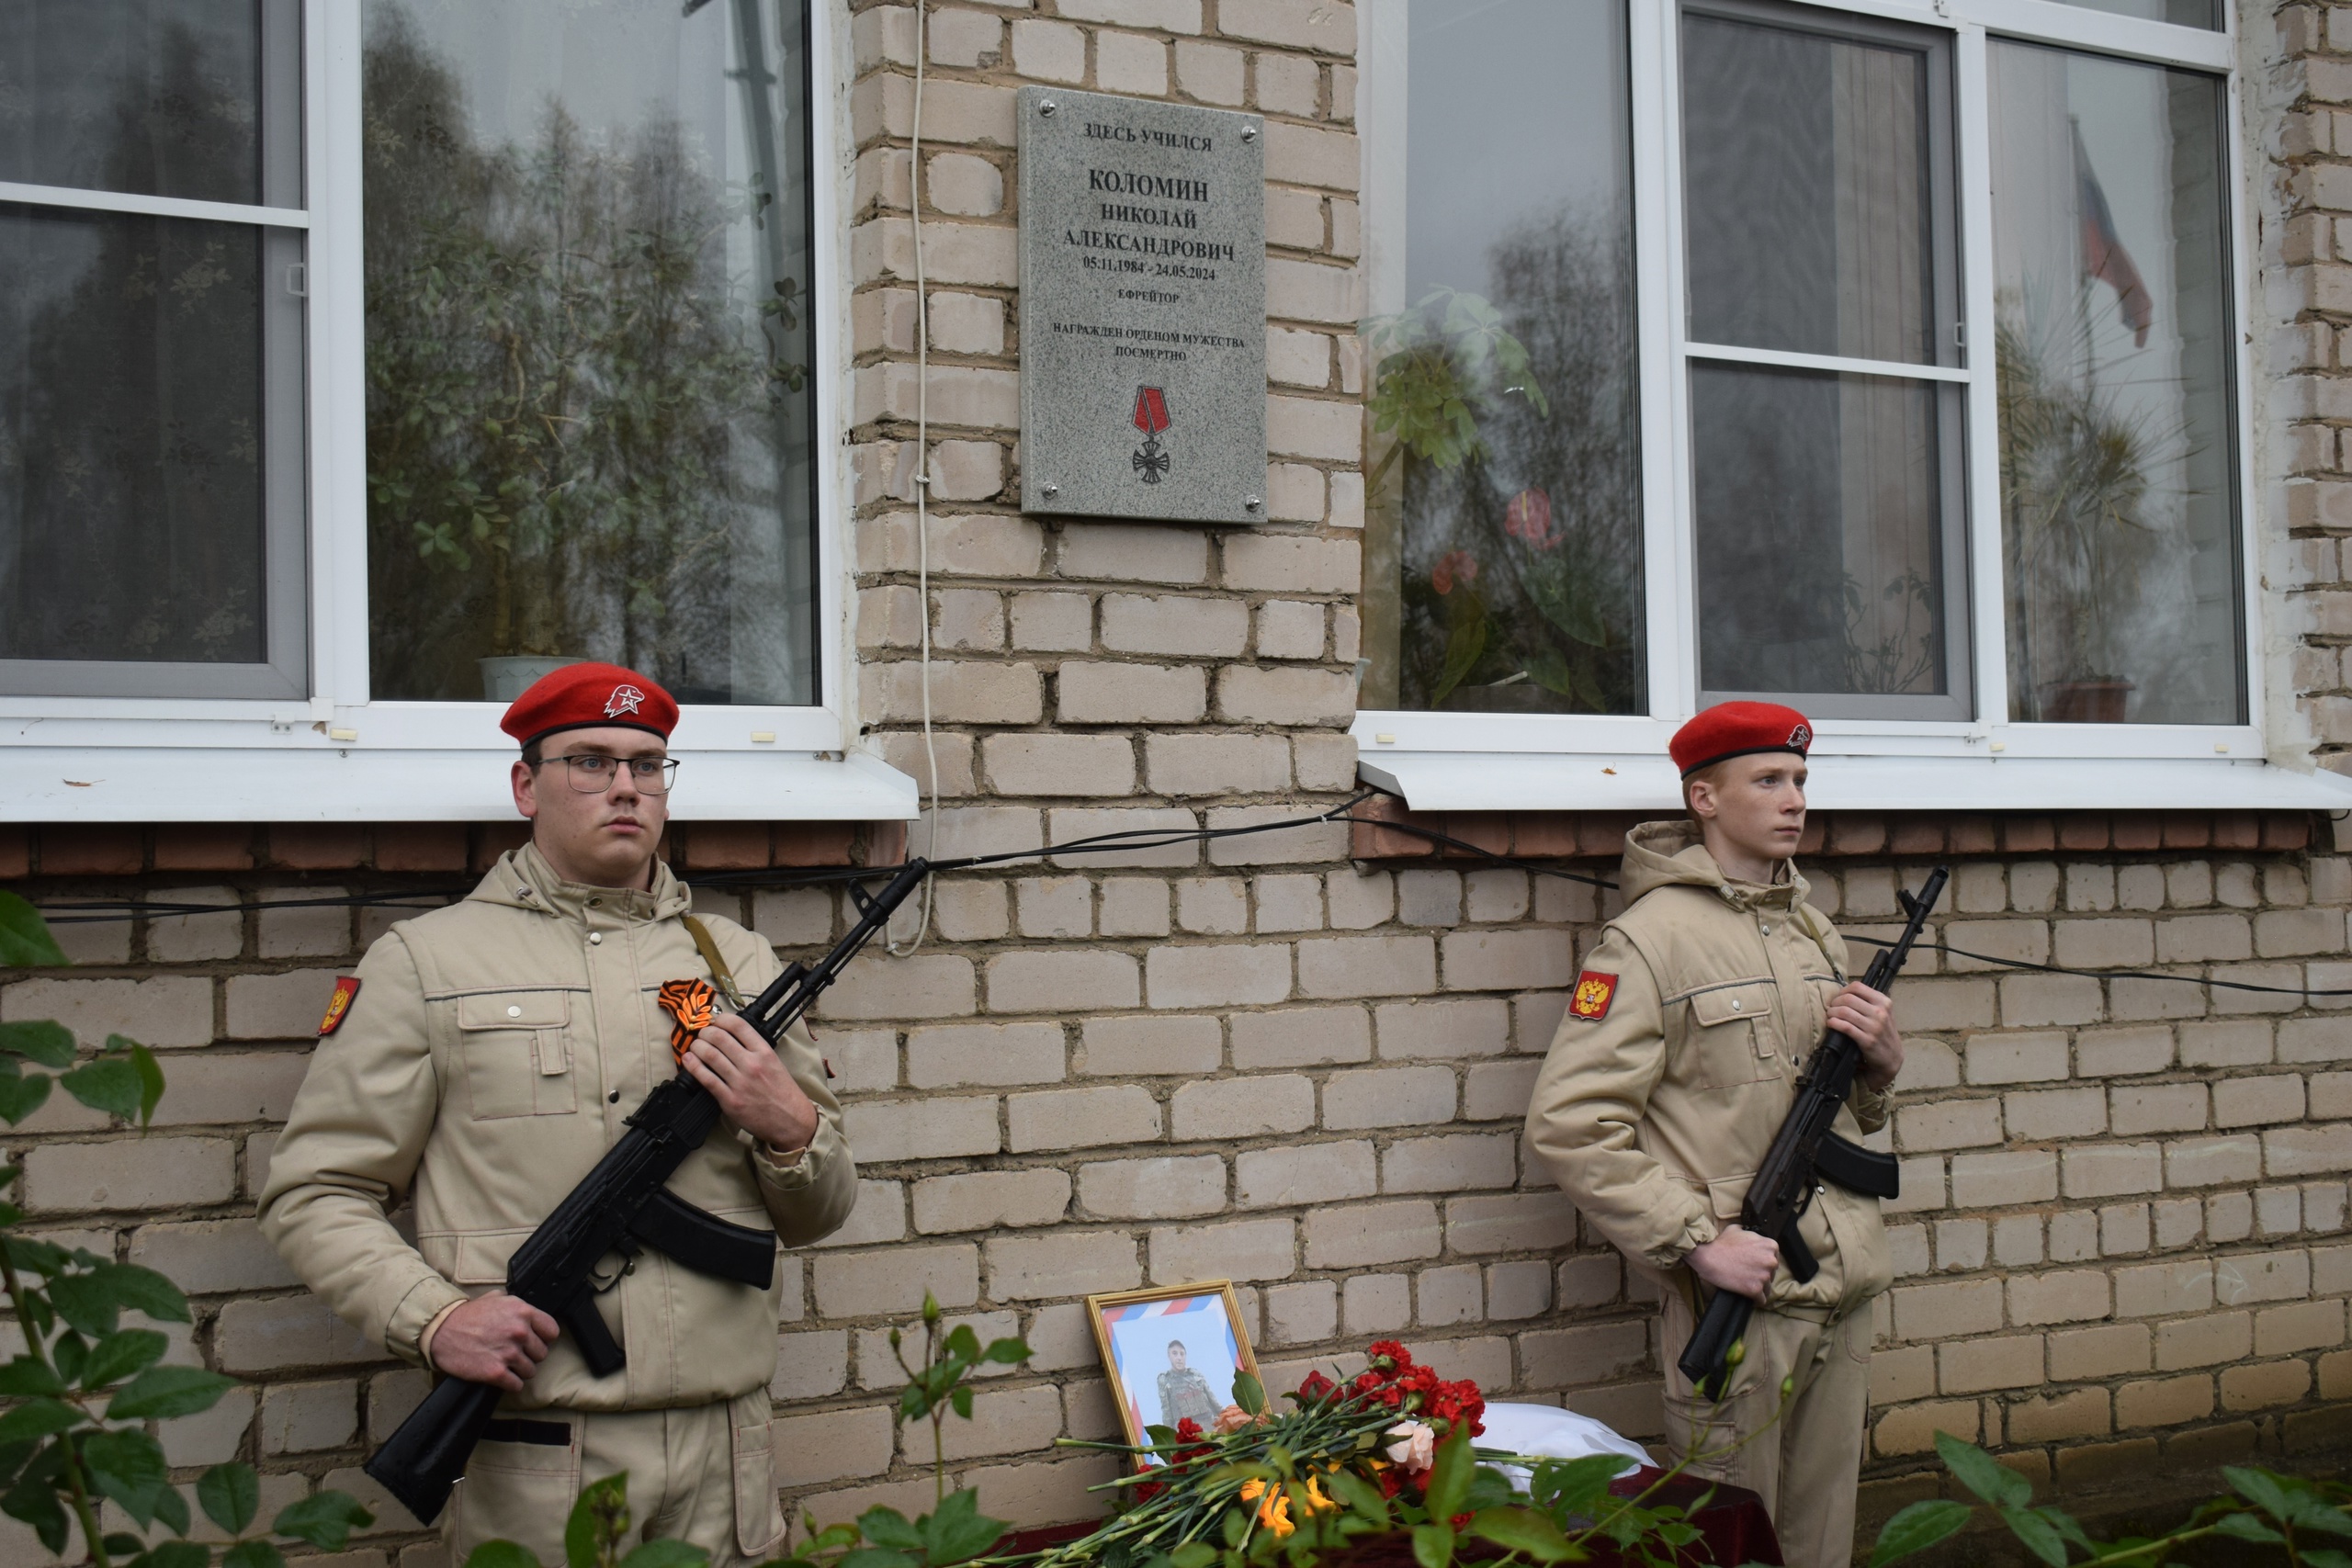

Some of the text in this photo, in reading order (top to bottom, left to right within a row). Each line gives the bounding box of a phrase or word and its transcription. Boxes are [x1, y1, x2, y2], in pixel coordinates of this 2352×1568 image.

[1083, 122, 1213, 152] ЗДЕСЬ УЧИЛСЯ
[1089, 169, 1208, 202] КОЛОМИН
[1102, 203, 1197, 230] НИКОЛАЙ
[1063, 230, 1235, 262] АЛЕКСАНДРОВИЧ
[1083, 255, 1145, 274] 05.11.1984
[1155, 263, 1216, 281] 24.05.2024
[1118, 288, 1180, 304] ЕФРЕЙТОР
[1053, 322, 1245, 348] НАГРАЖДЕН ОРДЕНОМ МУЖЕСТВА
[1115, 345, 1187, 361] ПОСМЕРТНО
